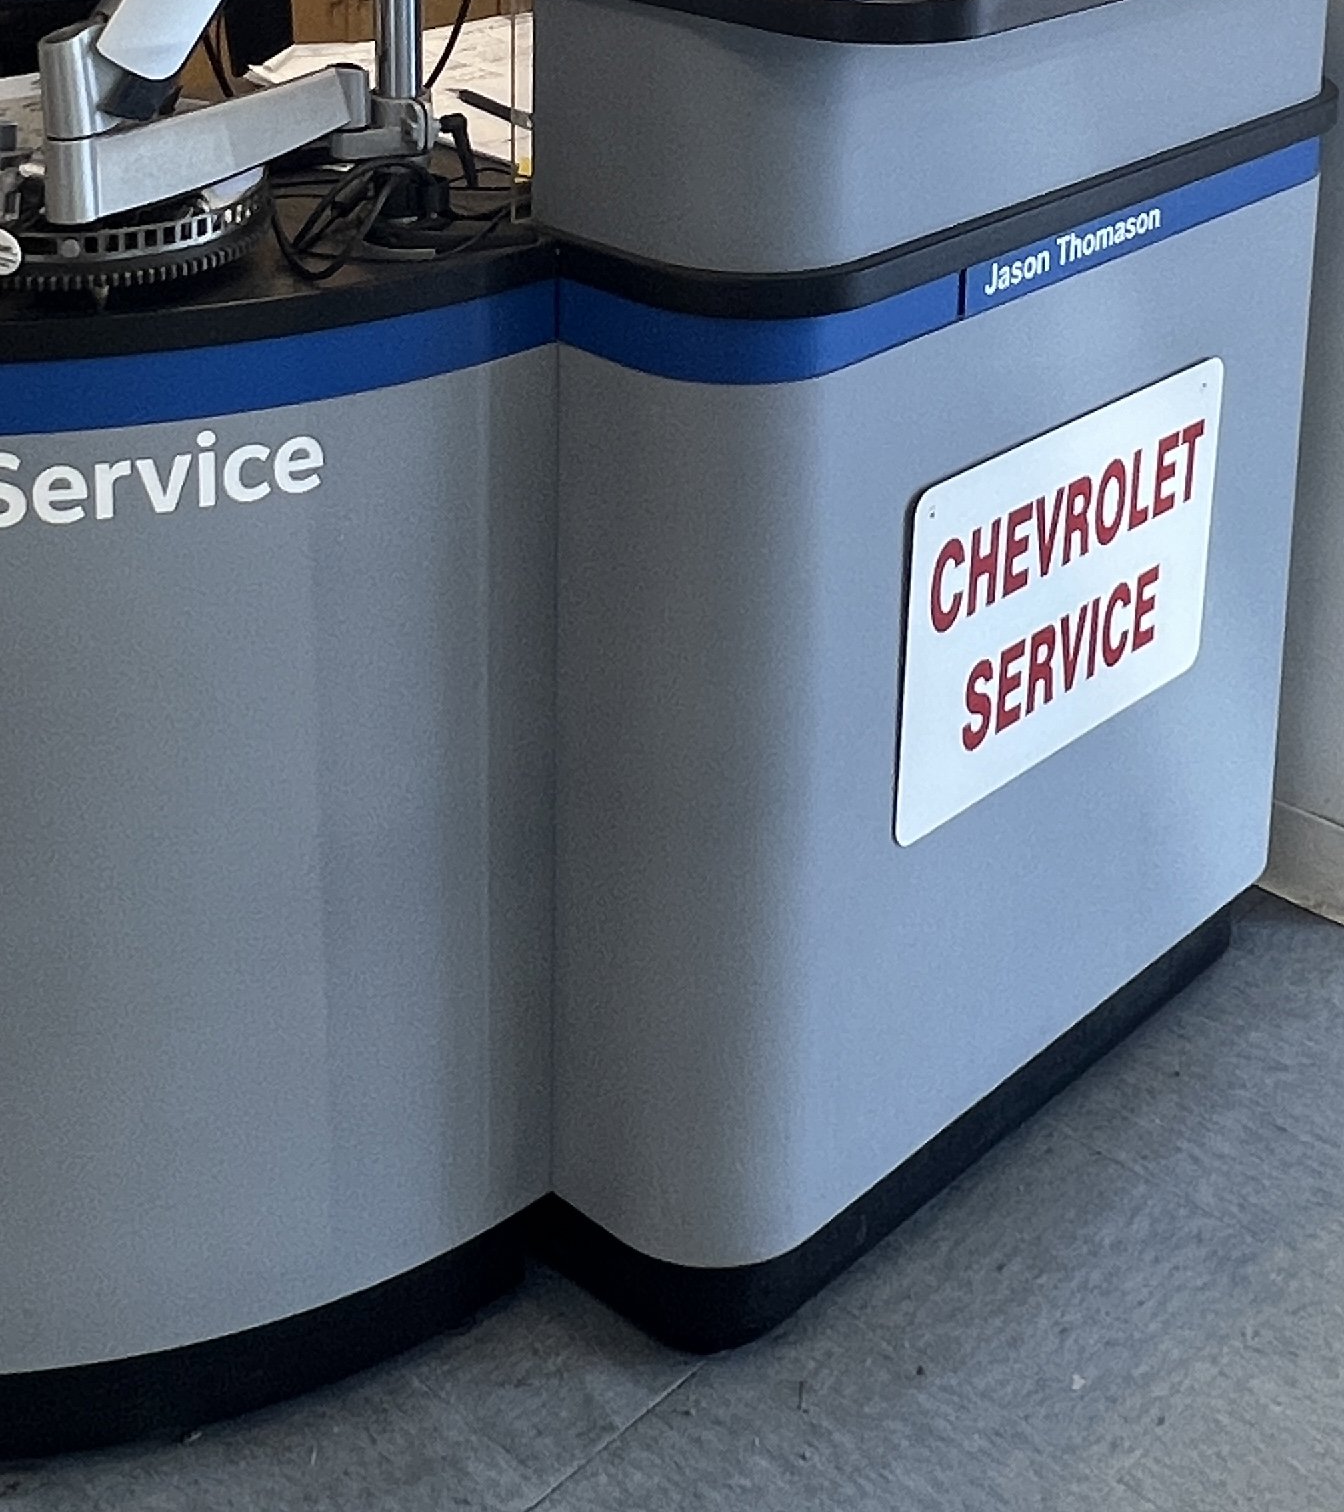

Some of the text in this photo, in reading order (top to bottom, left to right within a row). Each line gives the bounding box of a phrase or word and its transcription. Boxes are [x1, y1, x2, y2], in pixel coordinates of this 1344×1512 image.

[984, 207, 1162, 296] Jason Thomason
[929, 418, 1206, 635] CHEVROLET
[961, 563, 1161, 753] SERVICE
